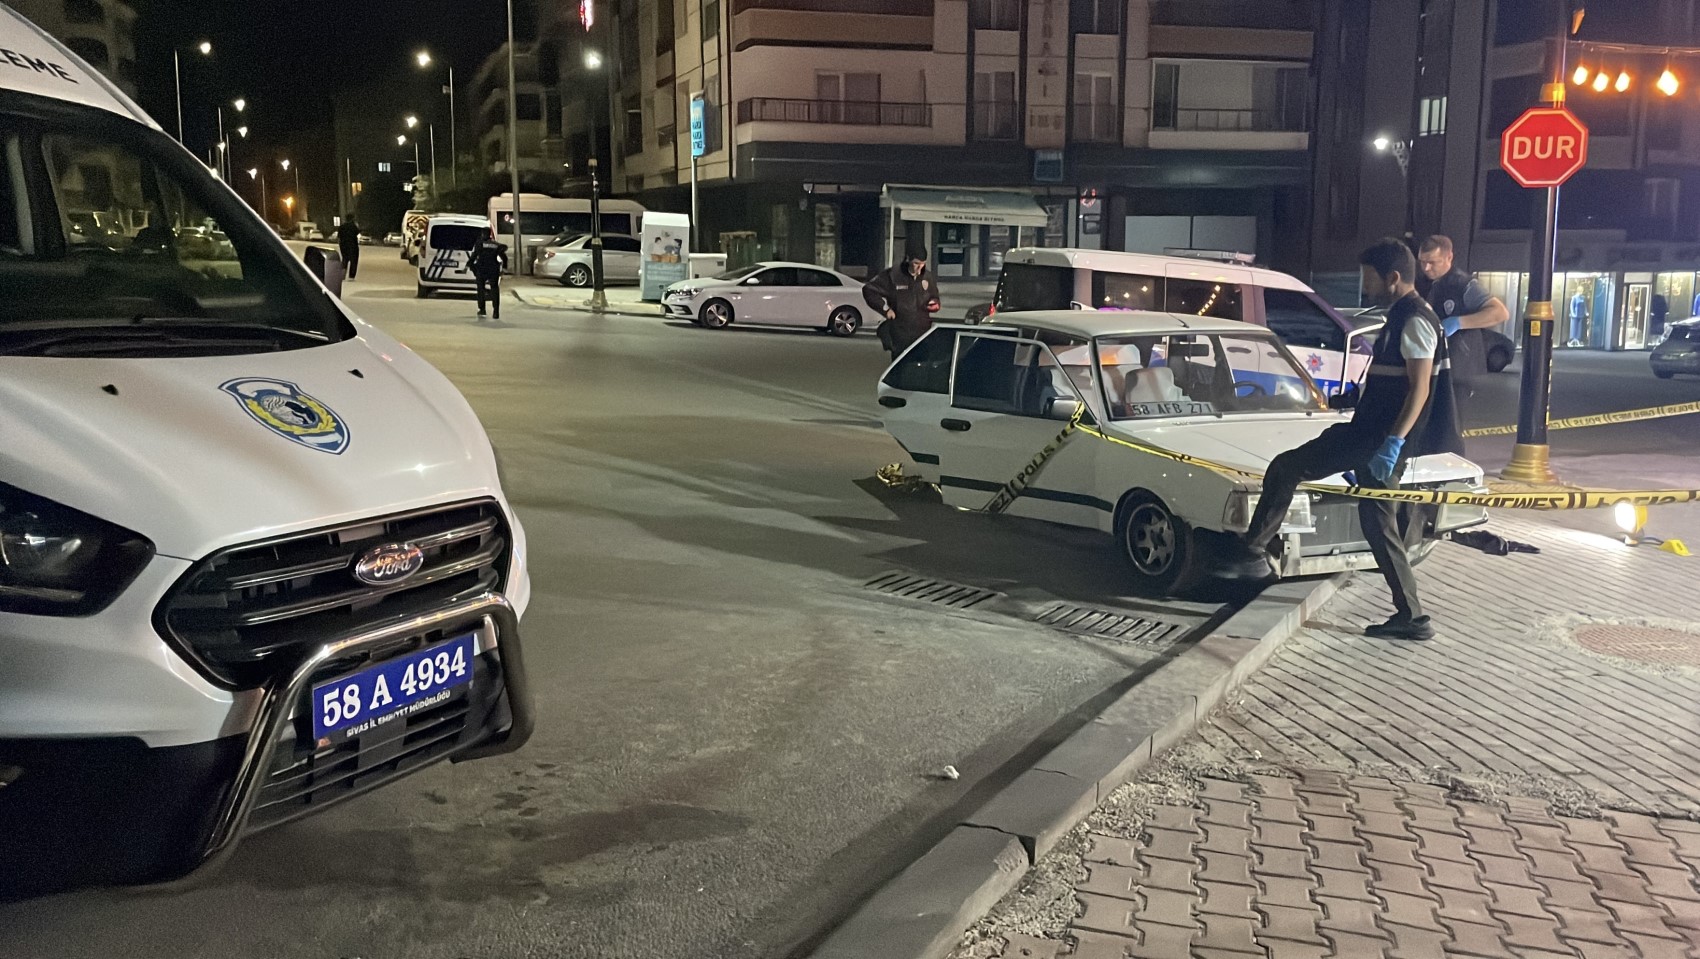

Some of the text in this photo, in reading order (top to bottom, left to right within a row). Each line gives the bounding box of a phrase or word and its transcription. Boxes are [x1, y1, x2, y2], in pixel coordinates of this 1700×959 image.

[1512, 135, 1575, 160] DUR
[1132, 404, 1150, 416] 58
[1157, 403, 1182, 414] AFB
[373, 554, 412, 578] Ford
[323, 645, 466, 727] 58 A 4934
